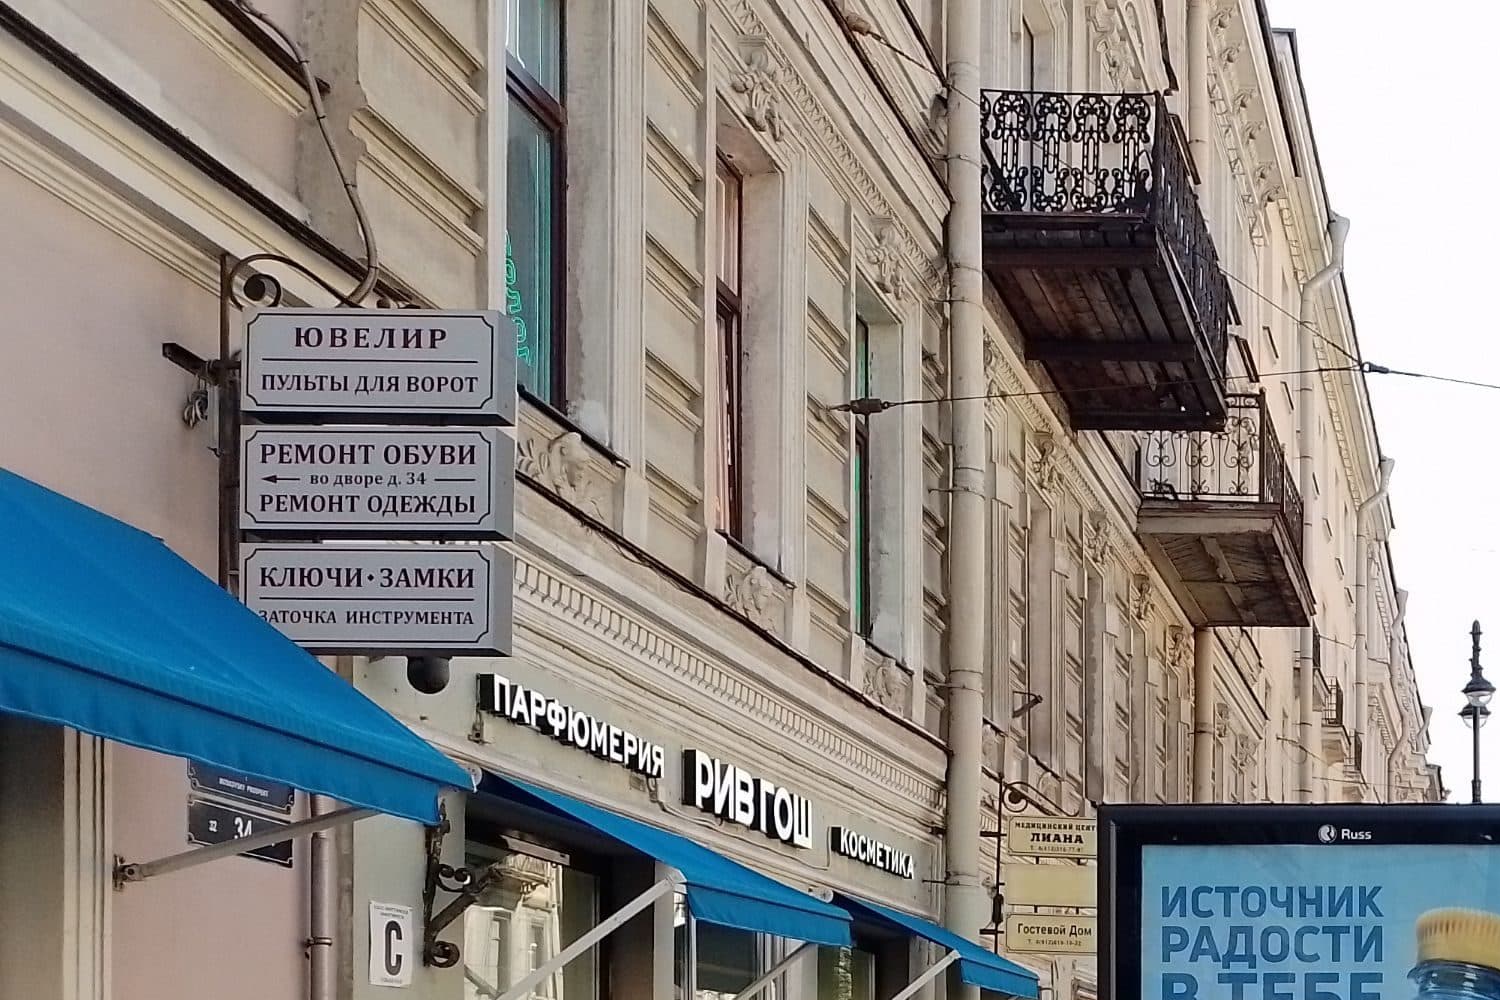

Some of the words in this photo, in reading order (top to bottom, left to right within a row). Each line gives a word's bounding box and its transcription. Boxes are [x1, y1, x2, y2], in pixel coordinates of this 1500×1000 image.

[295, 327, 447, 349] ЮВЕЛИР
[262, 374, 348, 391] ПУЛЬТЫ
[354, 375, 400, 395] ДЛЯ
[406, 376, 478, 393] ВОРОТ
[260, 443, 375, 465] РЕМОНТ
[383, 444, 476, 465] ОБУВИ
[310, 474, 330, 485] во
[333, 474, 383, 488] дворе
[387, 475, 401, 488] д.
[406, 471, 426, 485] 34
[260, 494, 357, 514] РЕМОНТ
[367, 495, 476, 518] ОДЕЖДЫ
[259, 567, 363, 588] КЛЮЧИ
[379, 568, 475, 589] ЗАМКИ
[346, 610, 474, 625] ИНСТРУМЕНТА
[493, 673, 666, 779] ПАРФЮМЕРИЯ
[695, 748, 755, 828] РИВ
[760, 777, 814, 849] ГОШ
[1015, 821, 1074, 831] МЕДИЦИНСКИЙ
[1075, 824, 1097, 832] ЦЕНТ
[1341, 827, 1372, 841] Russ
[1030, 832, 1085, 845] ЛИАНА
[840, 828, 915, 880] КОСМЕТИКА
[1160, 885, 1384, 918] ИСТОЧНИК
[1017, 923, 1066, 936] Гостевой
[1069, 924, 1092, 938] Дом
[1161, 925, 1383, 969] РАДОСТИ
